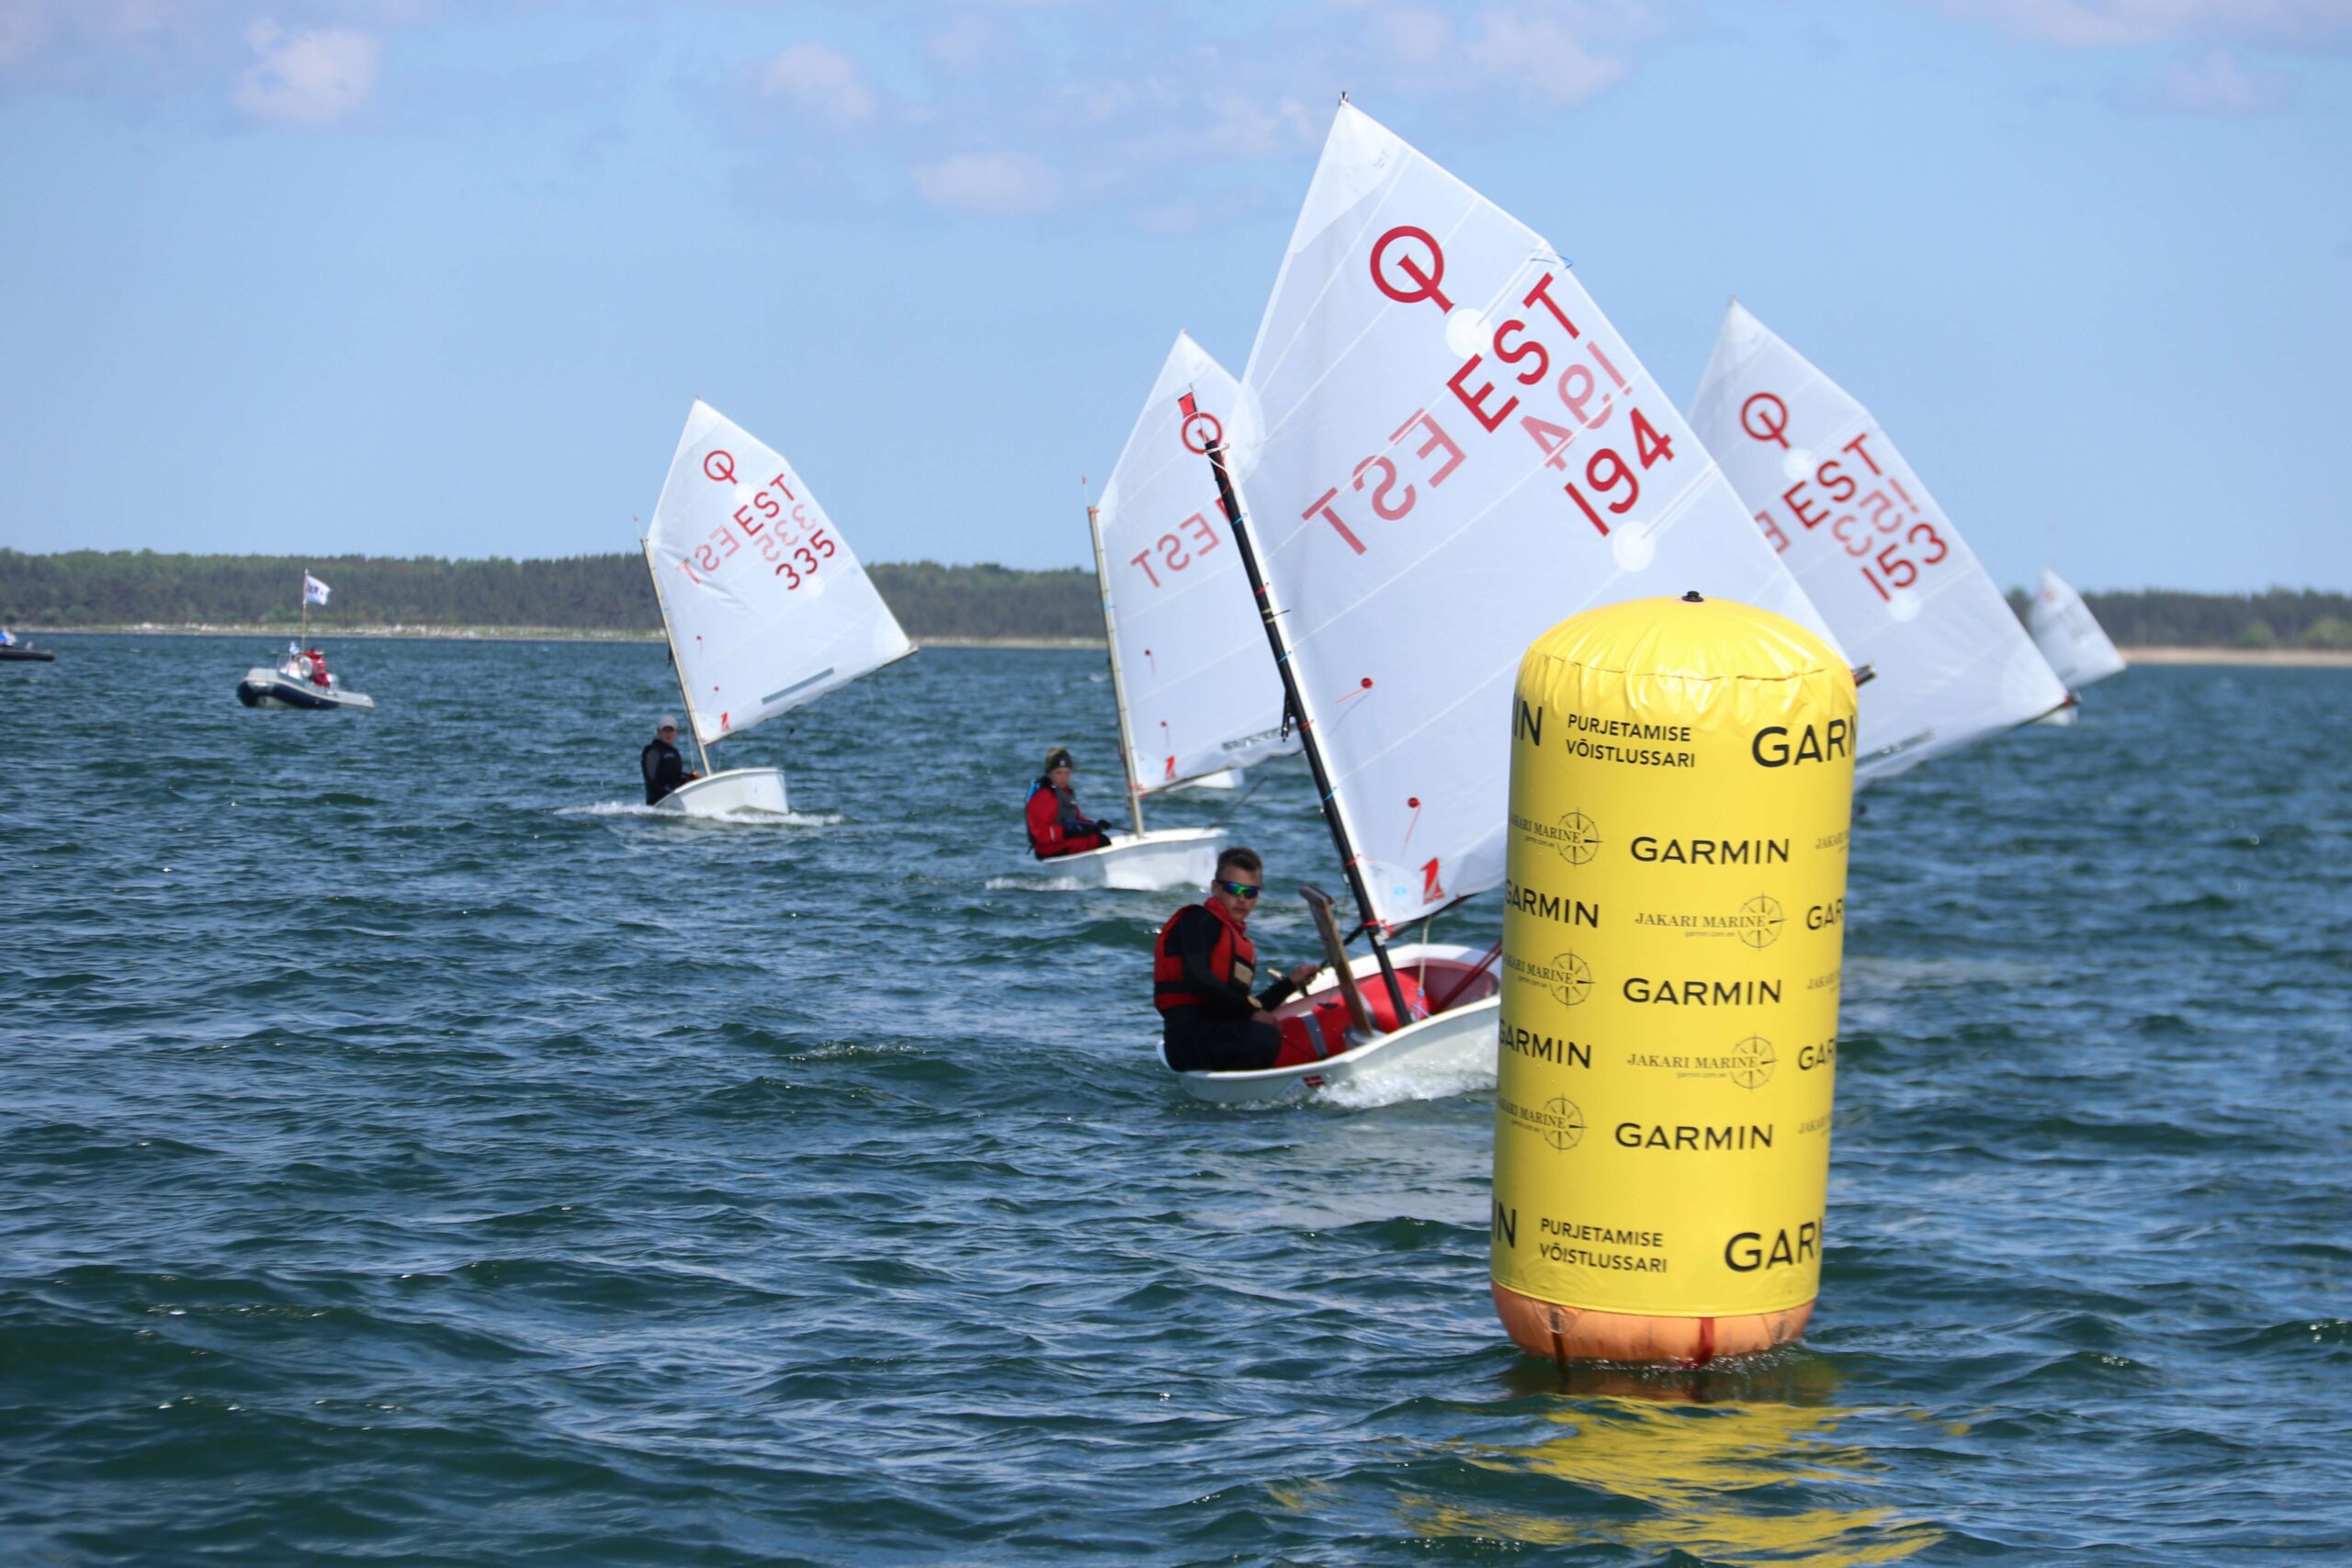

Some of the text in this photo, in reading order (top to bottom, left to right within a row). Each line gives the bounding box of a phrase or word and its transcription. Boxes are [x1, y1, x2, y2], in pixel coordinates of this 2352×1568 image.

[1446, 272, 1580, 434] EST
[1564, 407, 1674, 536] 194
[1781, 432, 1883, 530] EST
[732, 473, 797, 537] EST
[775, 528, 836, 591] 335
[1860, 523, 1949, 603] 153
[1567, 713, 1691, 742] PURJETAMISE
[1566, 738, 1695, 768] VÕISTLUSSARI
[1533, 822, 1581, 844] MARINE
[1630, 836, 1790, 865] GARMIN
[1634, 912, 1766, 928] JAKARI MARINE
[1527, 962, 1574, 985] MARINE
[1623, 977, 1782, 1007] GARMIN
[1627, 1054, 1758, 1069] JAKARI MARINE
[1520, 1106, 1566, 1130] MARINE
[1615, 1122, 1774, 1151] GARMIN
[1540, 1218, 1664, 1247] PURJETAMISE
[1724, 1216, 1823, 1273] GAR
[1539, 1242, 1668, 1273] VÕISTLUSSARI
